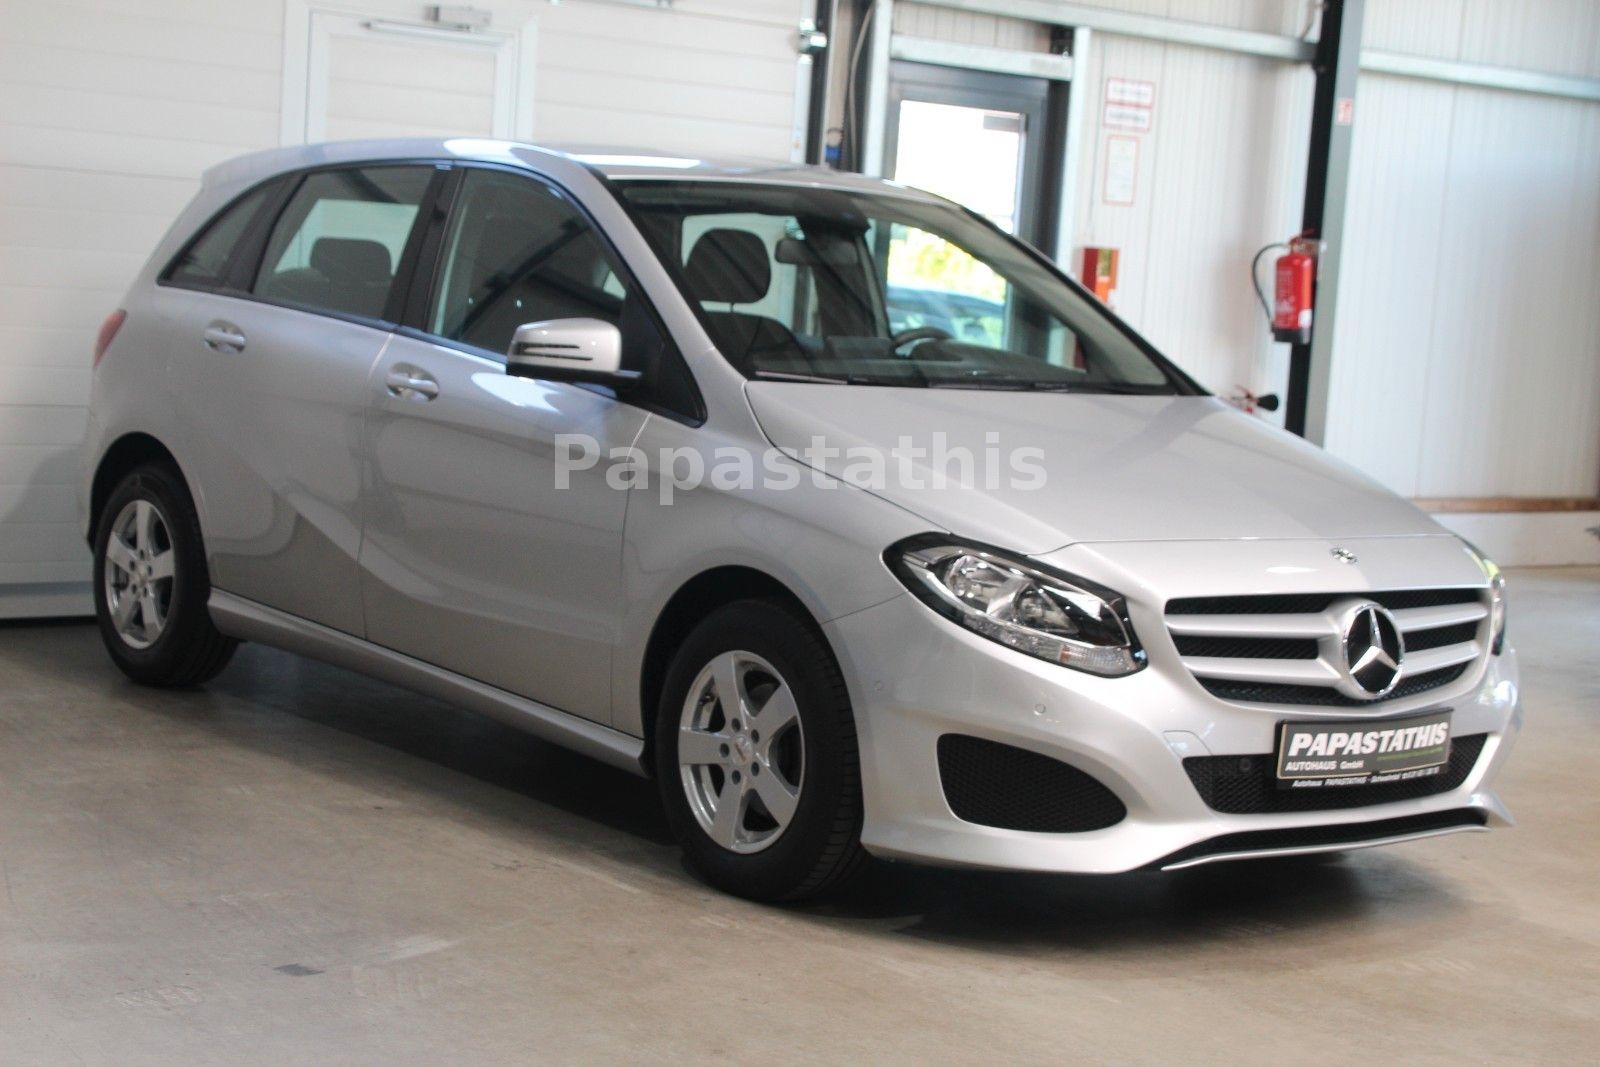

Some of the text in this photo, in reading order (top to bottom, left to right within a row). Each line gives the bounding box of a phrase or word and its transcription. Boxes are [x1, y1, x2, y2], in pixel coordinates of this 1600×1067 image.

[1287, 721, 1449, 757] PAPASTATHIS
[1285, 759, 1365, 771] AUTOHAUS GmbH
